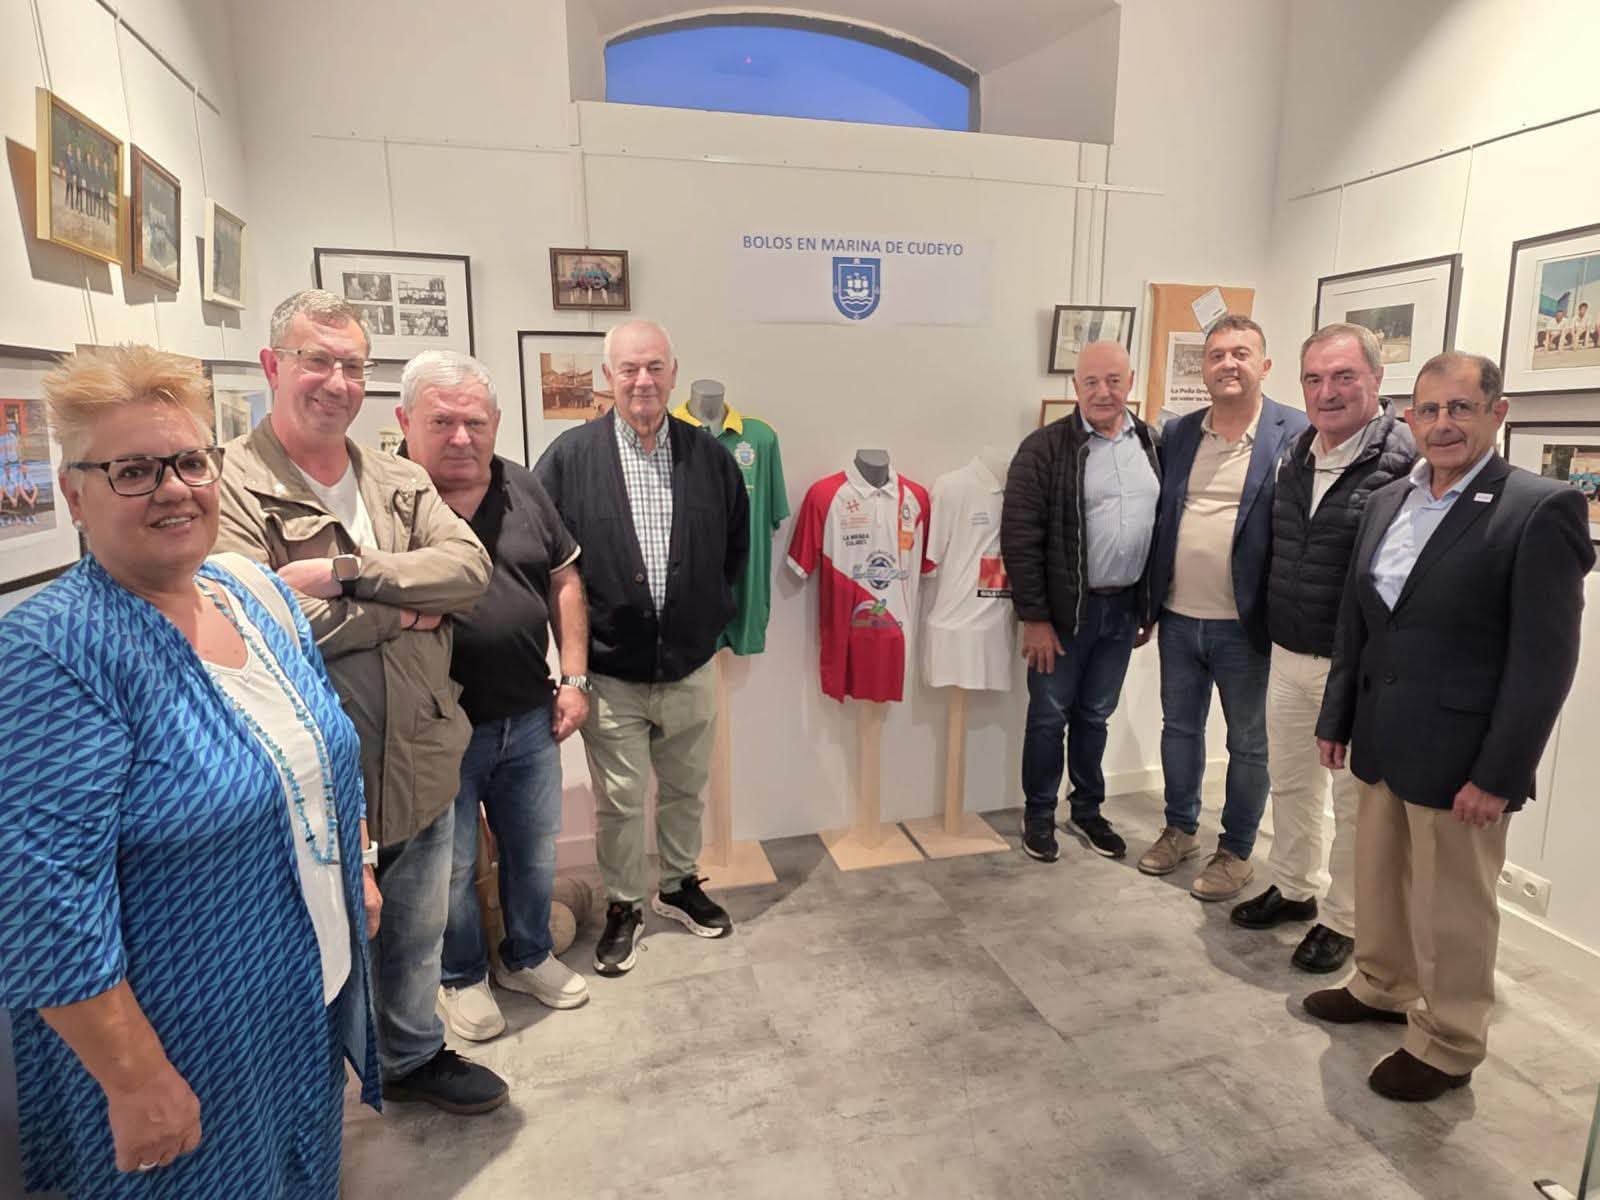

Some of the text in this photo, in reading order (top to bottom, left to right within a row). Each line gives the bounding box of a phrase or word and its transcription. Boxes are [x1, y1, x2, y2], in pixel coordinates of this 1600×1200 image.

[743, 235, 964, 256] BOLOS EN MARINA DE CUDEYO
